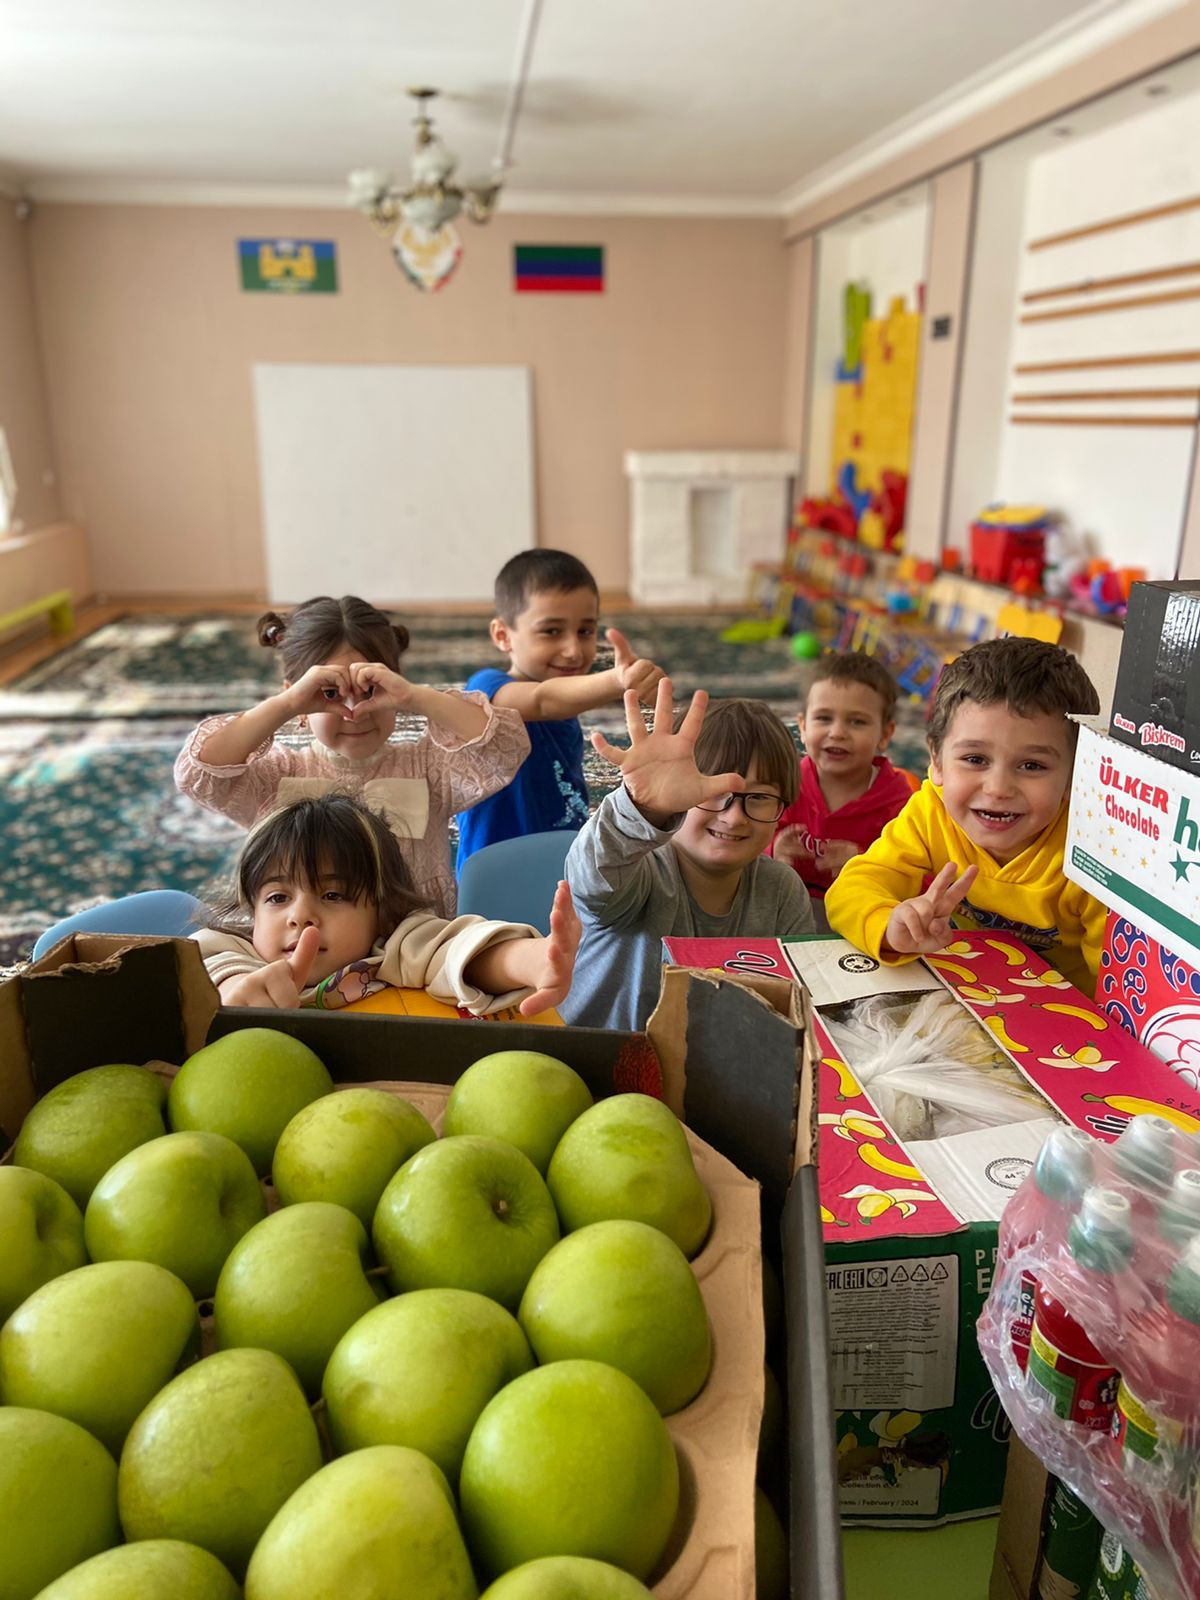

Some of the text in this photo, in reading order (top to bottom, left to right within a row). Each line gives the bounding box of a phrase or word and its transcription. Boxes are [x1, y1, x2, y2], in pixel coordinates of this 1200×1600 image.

[1114, 713, 1185, 752] ÜLKER Biskrem
[1099, 755, 1169, 814] ÜLKER
[1105, 794, 1160, 841] Chocolate
[1173, 795, 1200, 852] h
